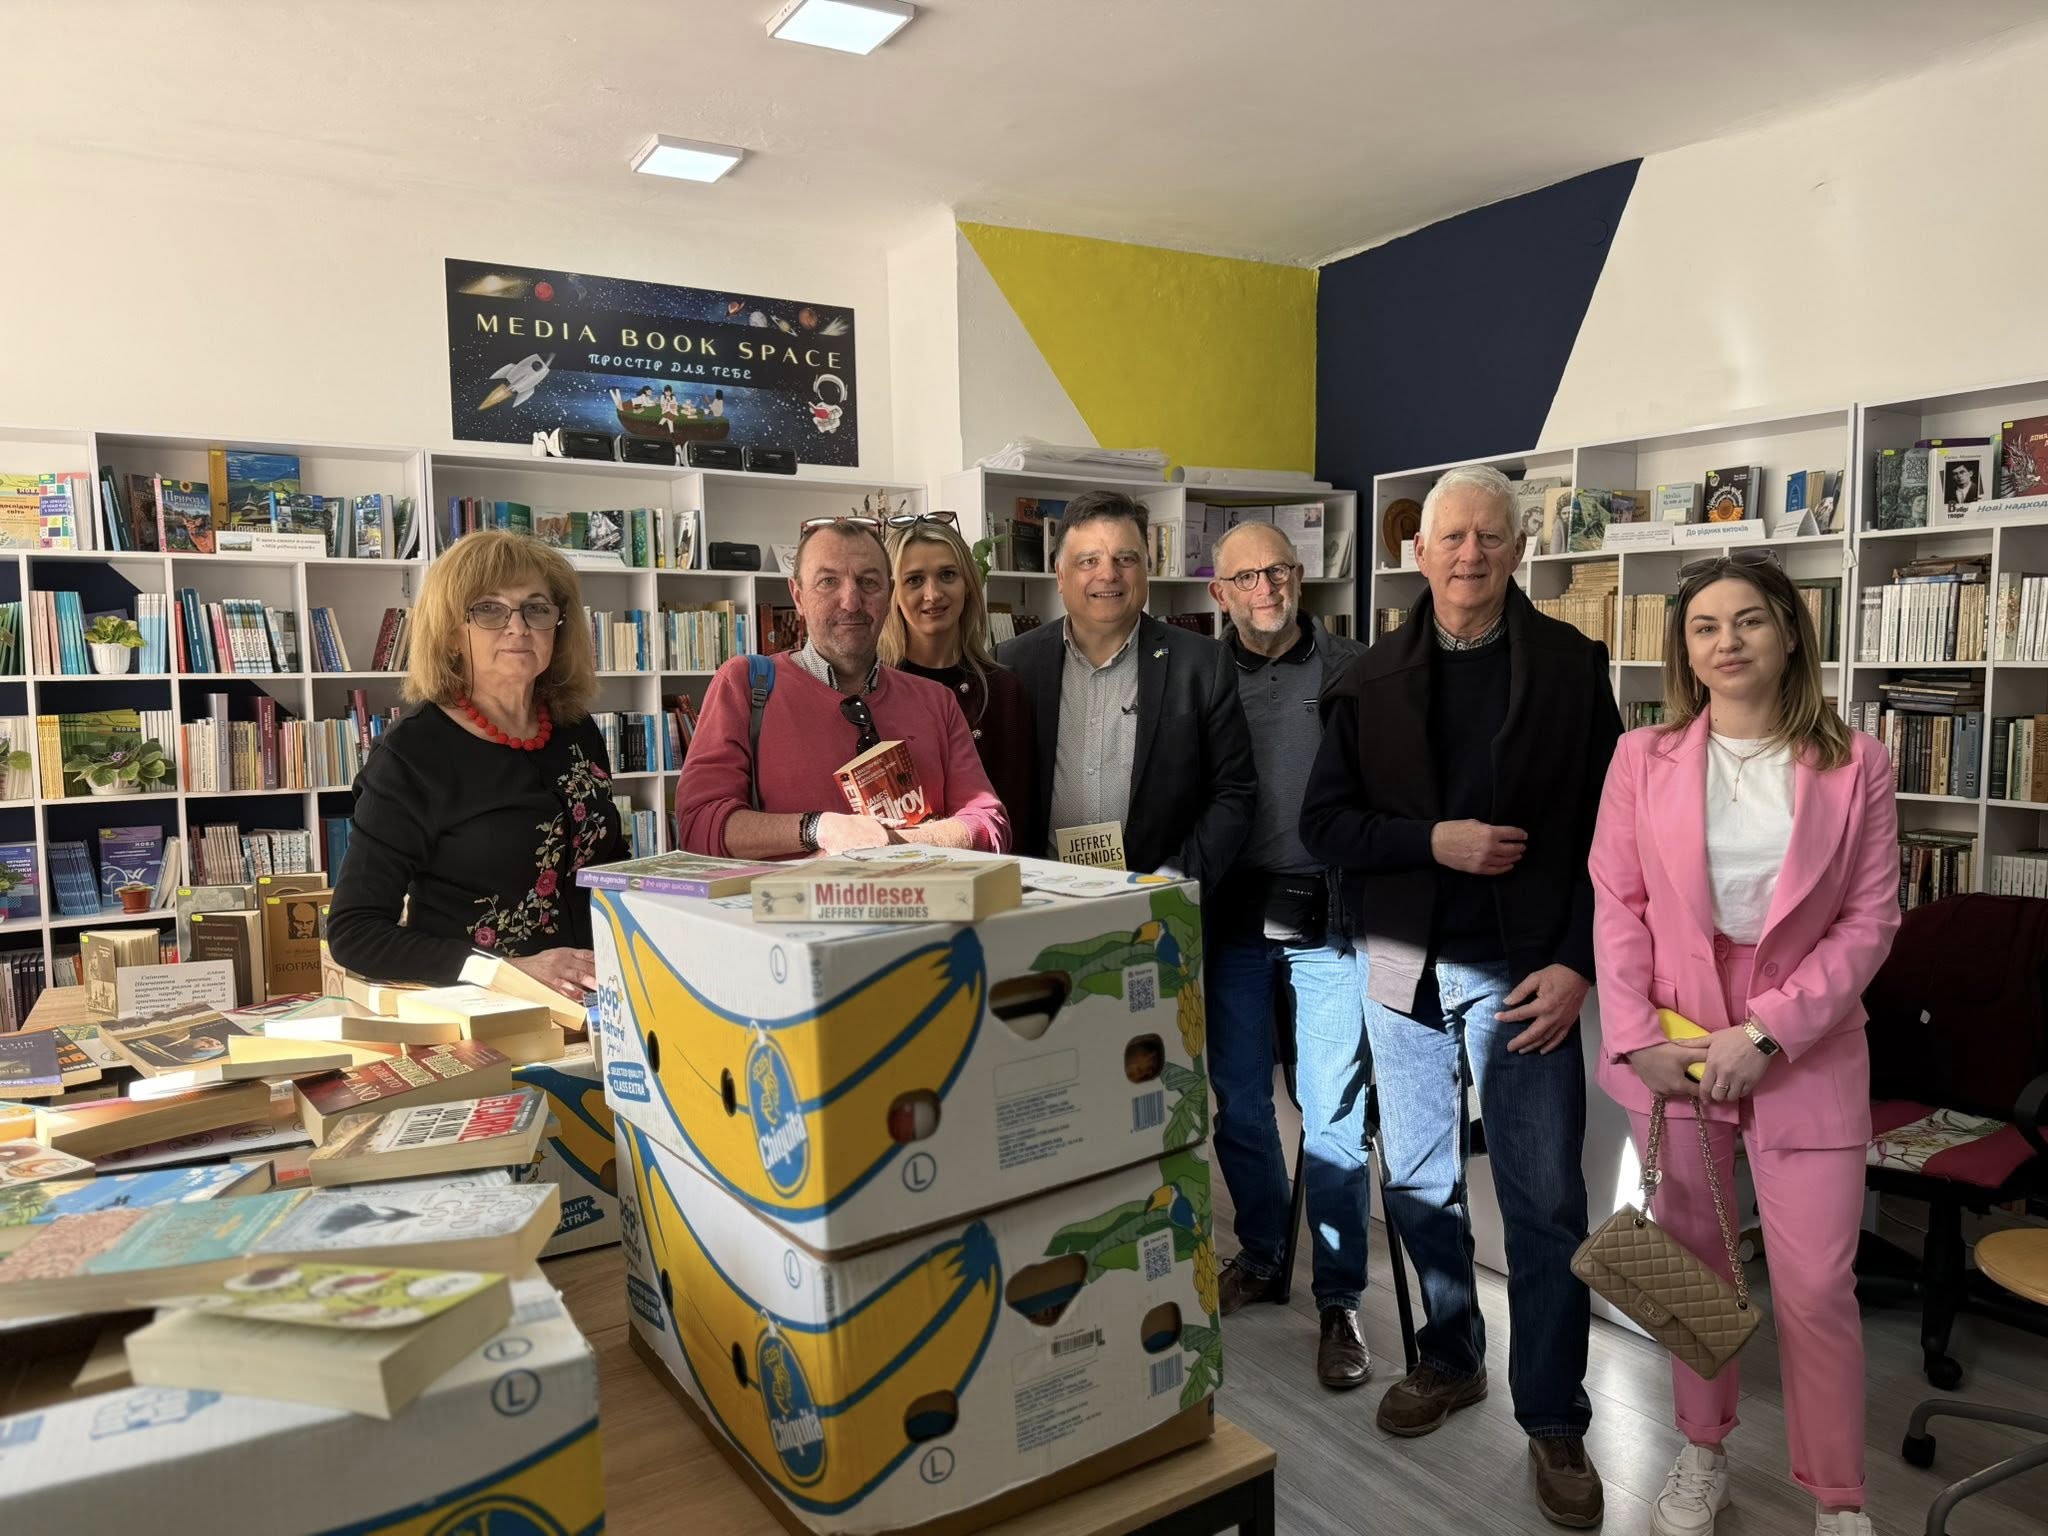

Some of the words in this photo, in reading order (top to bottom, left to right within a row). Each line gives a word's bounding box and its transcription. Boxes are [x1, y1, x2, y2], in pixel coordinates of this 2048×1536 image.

[476, 313, 597, 343] MEDIA
[621, 328, 717, 356] BOOK
[738, 341, 842, 369] SPACE
[588, 353, 663, 372] ПРОСТІР
[671, 362, 706, 376] ДЛЯ
[712, 366, 752, 380] ТЕБЕ
[1977, 503, 2002, 512] Нові
[2005, 500, 2048, 511] надход
[1686, 528, 1697, 537] До
[1698, 527, 1722, 537] рідних
[1722, 525, 1749, 534] витоків
[866, 789, 890, 808] JAMES
[868, 785, 925, 819] Ellroy
[1070, 834, 1112, 853] JEFFREY
[1062, 847, 1123, 866] EUGENIDES
[583, 873, 599, 883] jeffrey
[600, 874, 627, 885] eugenides
[646, 880, 656, 888] the
[816, 882, 925, 905] Middlesex
[818, 907, 864, 919] JEFFREY
[868, 906, 929, 919] EUGENIDES
[599, 984, 619, 1017] pop
[603, 1019, 625, 1041] nature
[368, 1064, 403, 1089] ROBERTO
[613, 1082, 628, 1093] CLASS
[628, 1082, 645, 1096] EXTRA
[412, 1107, 445, 1119] OF
[438, 1107, 473, 1124] OUR
[394, 1117, 439, 1147] TRAITOR
[428, 1121, 464, 1140] KIND
[758, 1106, 809, 1170] Chiquita
[560, 1200, 590, 1216] ALITY
[559, 1210, 591, 1229] XTRA
[771, 1405, 824, 1457] Chiquita
